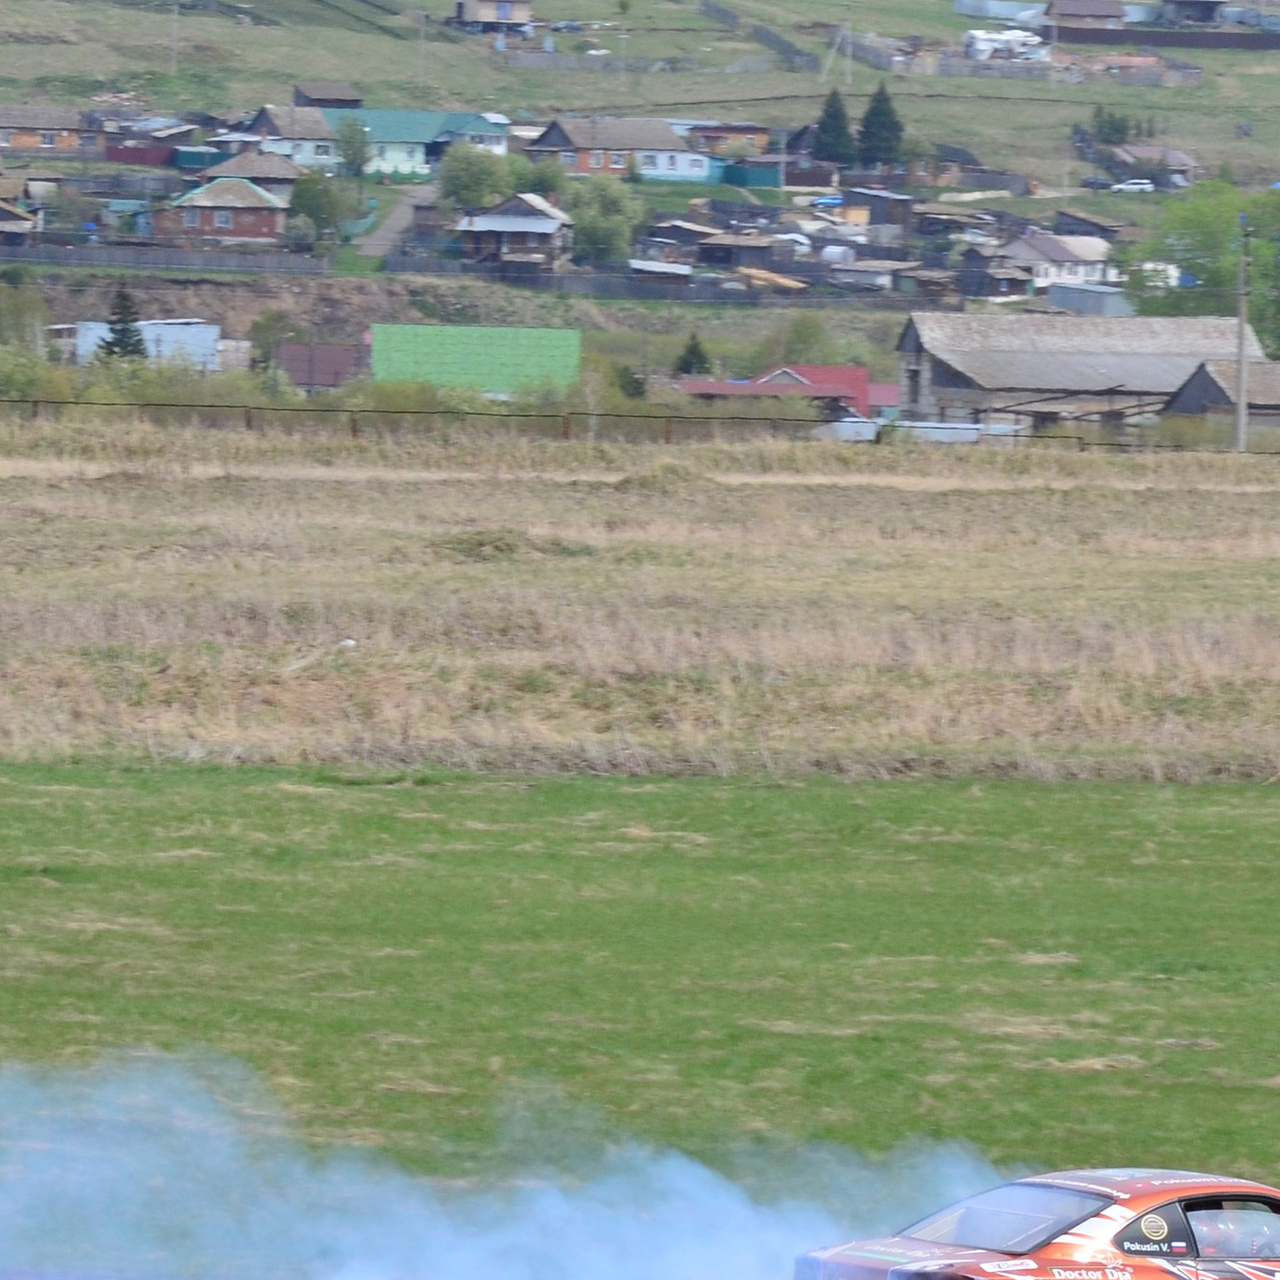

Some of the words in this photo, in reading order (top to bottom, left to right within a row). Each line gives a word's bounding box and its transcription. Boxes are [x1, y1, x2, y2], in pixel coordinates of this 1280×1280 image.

[1123, 1242, 1160, 1251] Pokusin
[1161, 1243, 1171, 1252] V.
[1051, 1268, 1102, 1280] Doctor
